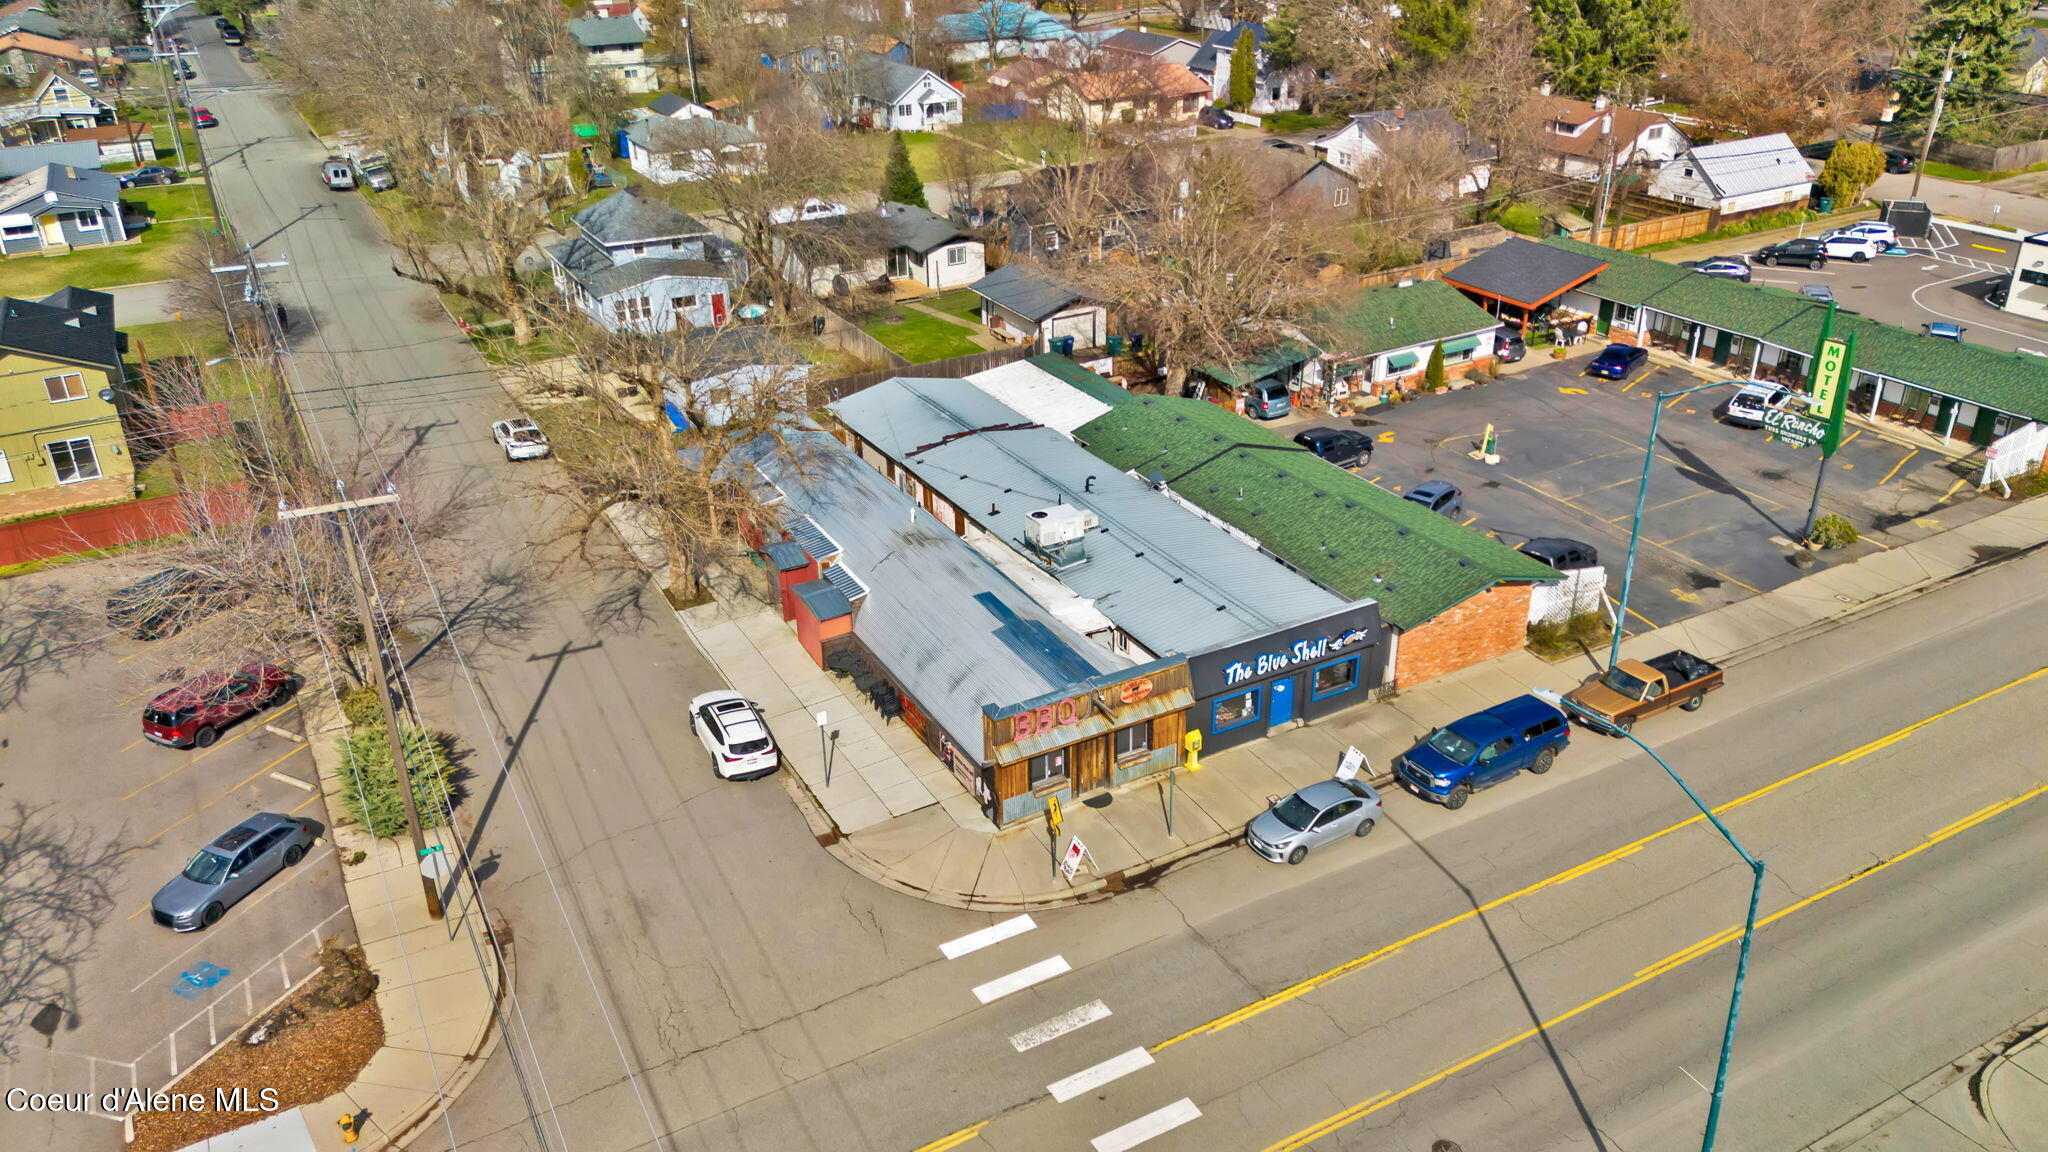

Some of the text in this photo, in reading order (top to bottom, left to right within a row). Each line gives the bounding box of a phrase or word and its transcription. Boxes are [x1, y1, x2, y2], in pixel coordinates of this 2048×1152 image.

[1817, 346, 1840, 414] MOTEL
[1765, 409, 1825, 439] El Rancho
[1225, 637, 1327, 685] The Blue Shell
[1013, 698, 1079, 742] BBQ
